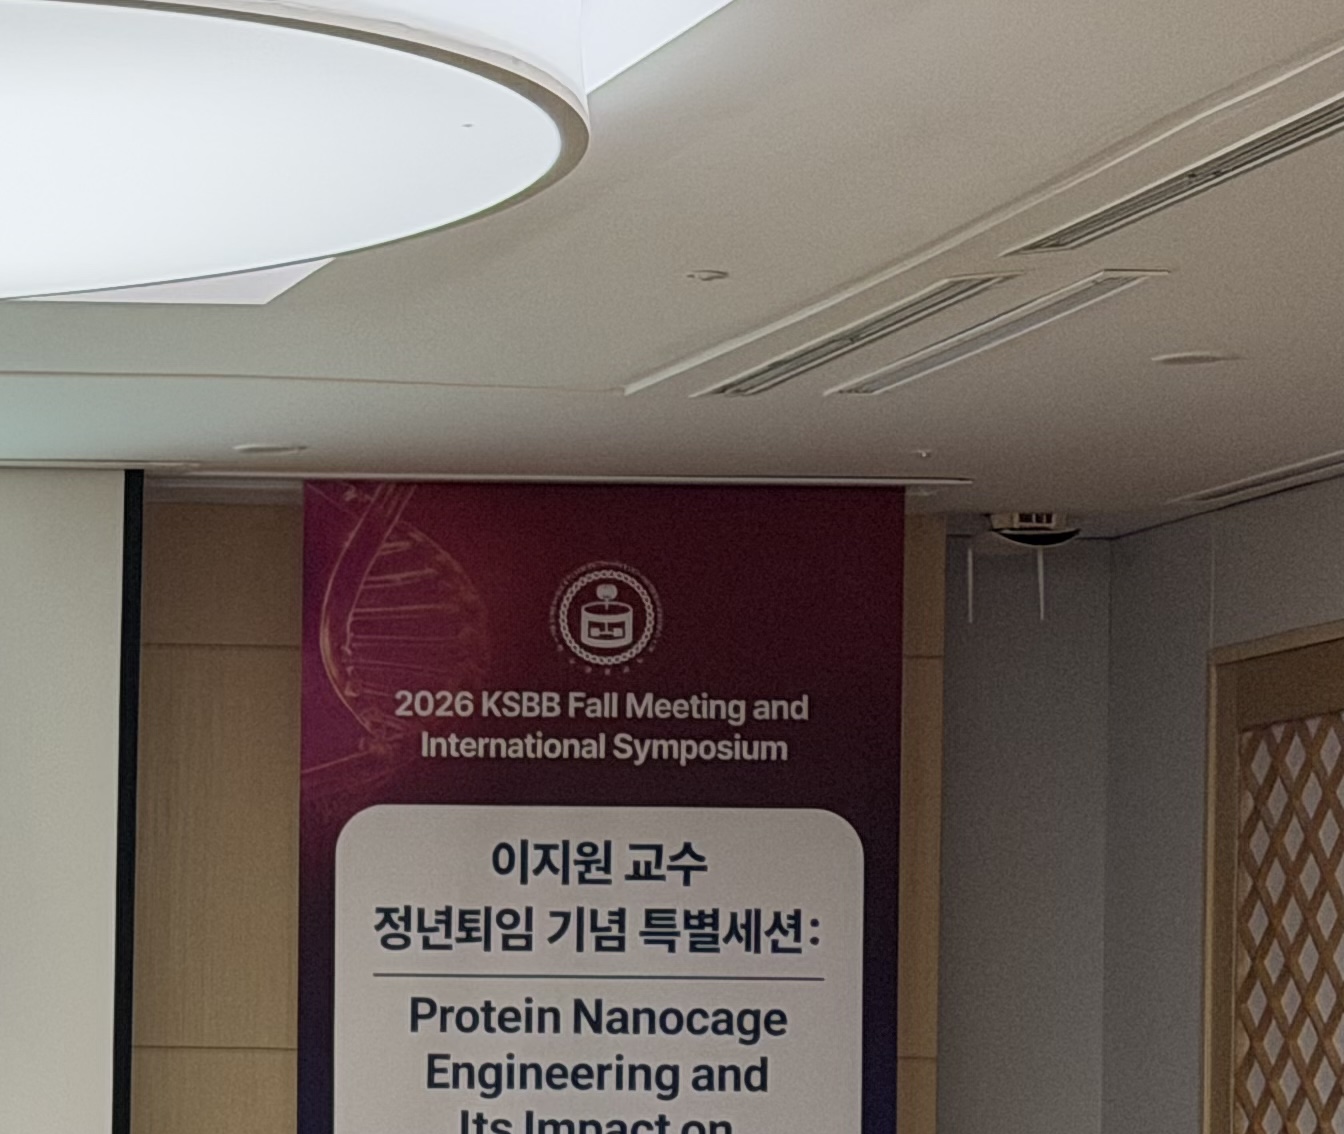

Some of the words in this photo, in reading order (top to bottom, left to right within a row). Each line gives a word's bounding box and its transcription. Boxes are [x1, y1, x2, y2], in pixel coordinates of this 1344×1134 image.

[394, 690, 474, 717] 2026
[481, 691, 561, 718] KSBB
[568, 692, 618, 719] Fall
[625, 693, 746, 725] Meeting
[752, 695, 809, 721] and
[421, 731, 606, 759] International
[612, 733, 788, 766] Symposium
[492, 839, 613, 885] 이지원
[624, 842, 708, 887] 교수
[373, 905, 534, 953] 정년퇴임
[547, 906, 626, 953] 기념
[639, 908, 820, 955] 특별세션:
[410, 996, 561, 1035] Protein
[573, 998, 788, 1045] Nanocage
[426, 1053, 680, 1100] Engineering
[691, 1056, 768, 1093] and
